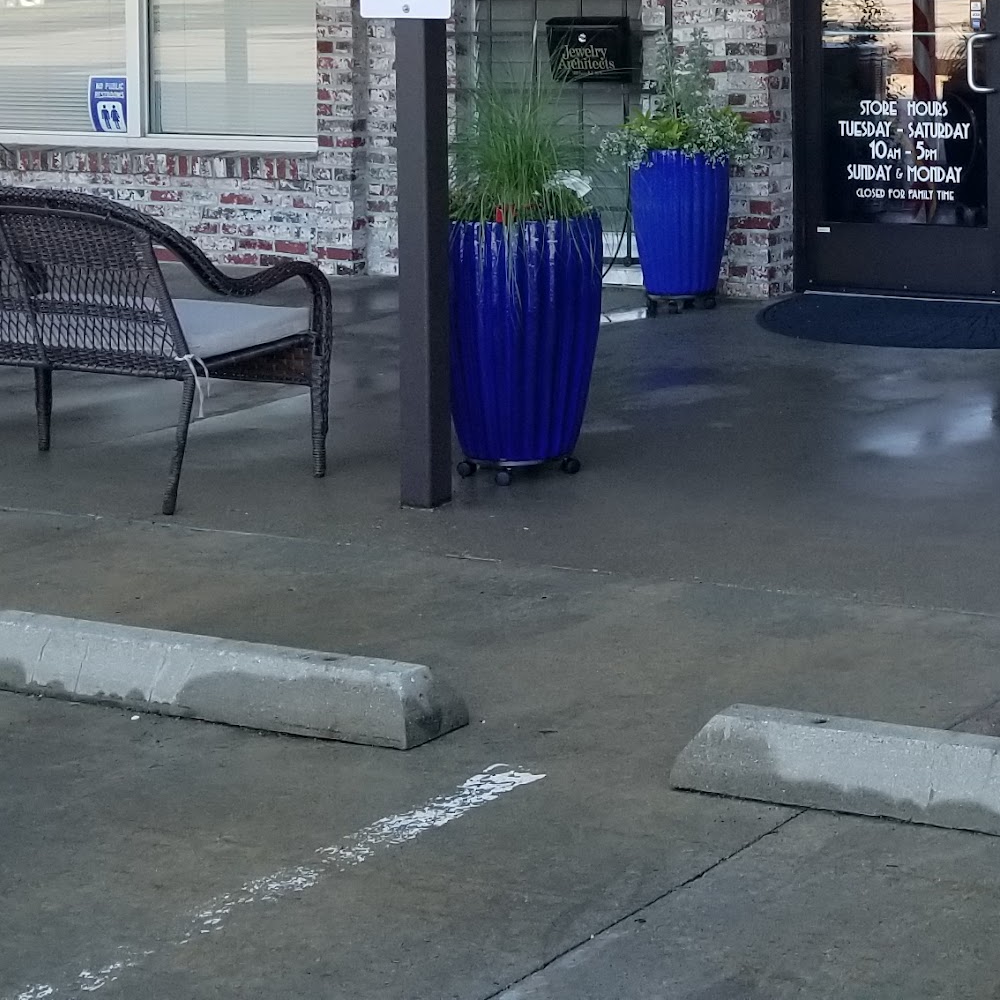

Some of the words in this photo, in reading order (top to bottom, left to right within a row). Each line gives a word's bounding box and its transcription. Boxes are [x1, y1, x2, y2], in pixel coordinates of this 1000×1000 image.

[562, 45, 607, 60] Jewelry
[559, 57, 615, 70] Architects
[860, 101, 897, 116] STORE
[907, 101, 948, 116] HOURS
[838, 121, 892, 137] TUESDAY
[908, 123, 970, 139] SATURDAY
[869, 140, 900, 160] 10AM
[916, 141, 937, 160] 5PM
[847, 164, 892, 181] SUNDAY
[896, 168, 903, 180] &
[907, 167, 962, 183] MONDAY
[856, 188, 885, 198] CLOSED
[888, 189, 905, 199] FOR
[908, 190, 934, 200] FAMILY
[937, 190, 954, 200] TIME
